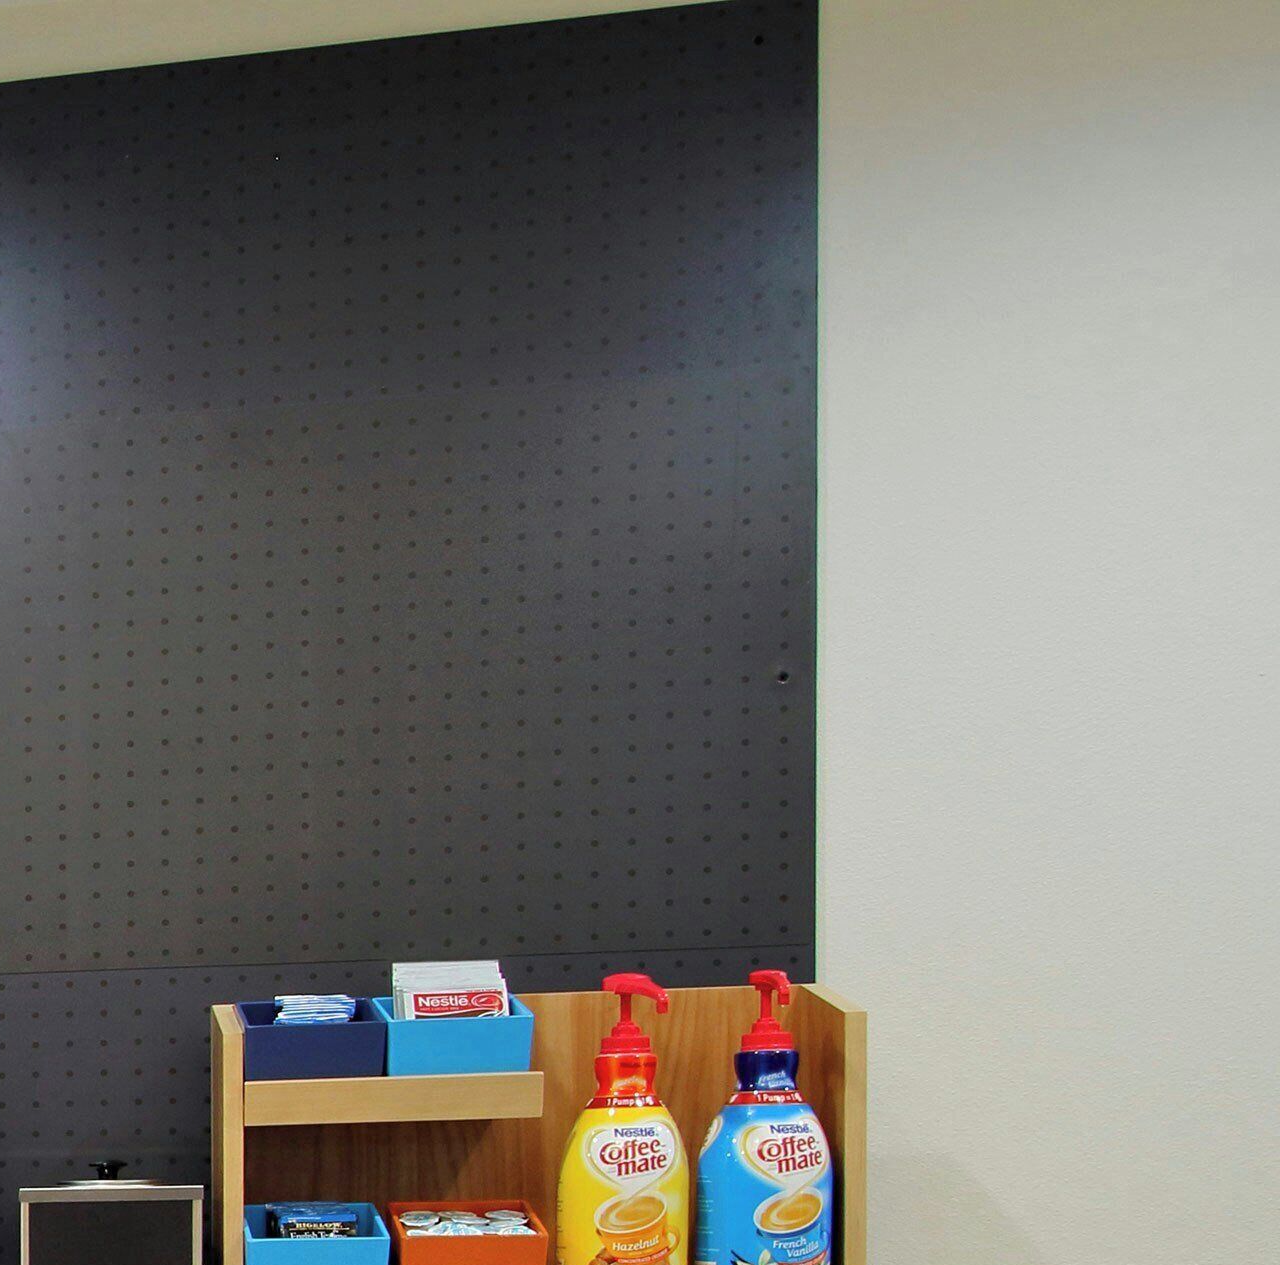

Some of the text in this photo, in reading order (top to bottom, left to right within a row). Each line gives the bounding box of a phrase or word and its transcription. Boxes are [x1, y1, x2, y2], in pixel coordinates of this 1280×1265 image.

[613, 1097, 635, 1106] Pump
[617, 1153, 667, 1176] mate
[777, 1150, 822, 1174] mate
[612, 1235, 660, 1251] Hazelnut
[773, 1236, 807, 1249] French
[786, 1241, 819, 1258] Vanilla
